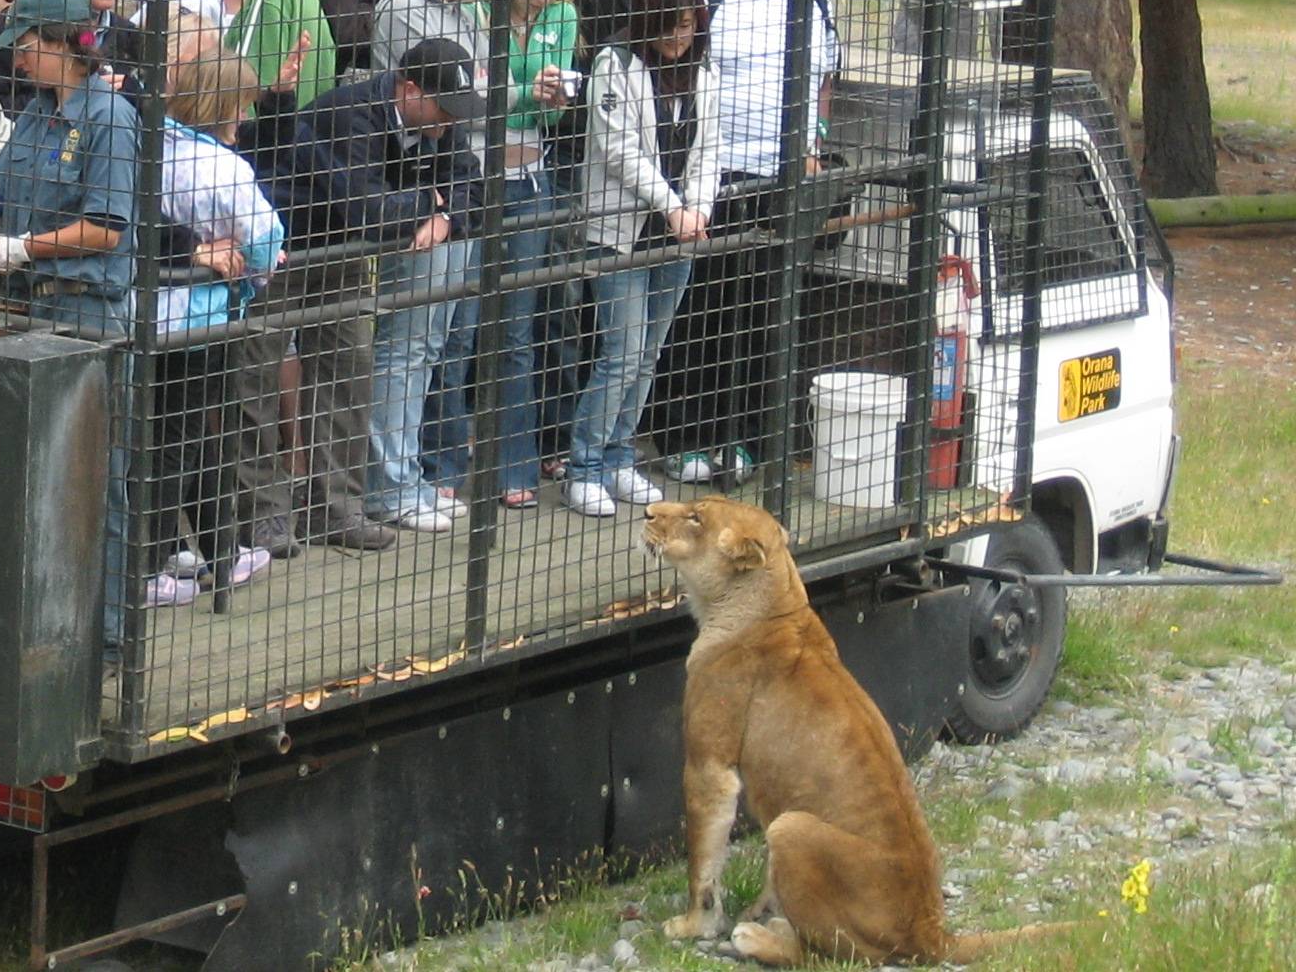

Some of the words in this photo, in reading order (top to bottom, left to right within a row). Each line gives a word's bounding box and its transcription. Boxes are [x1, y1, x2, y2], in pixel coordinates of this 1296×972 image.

[1082, 355, 1114, 376] Orana
[1082, 369, 1120, 395] Wildlife
[1081, 393, 1105, 415] Park
